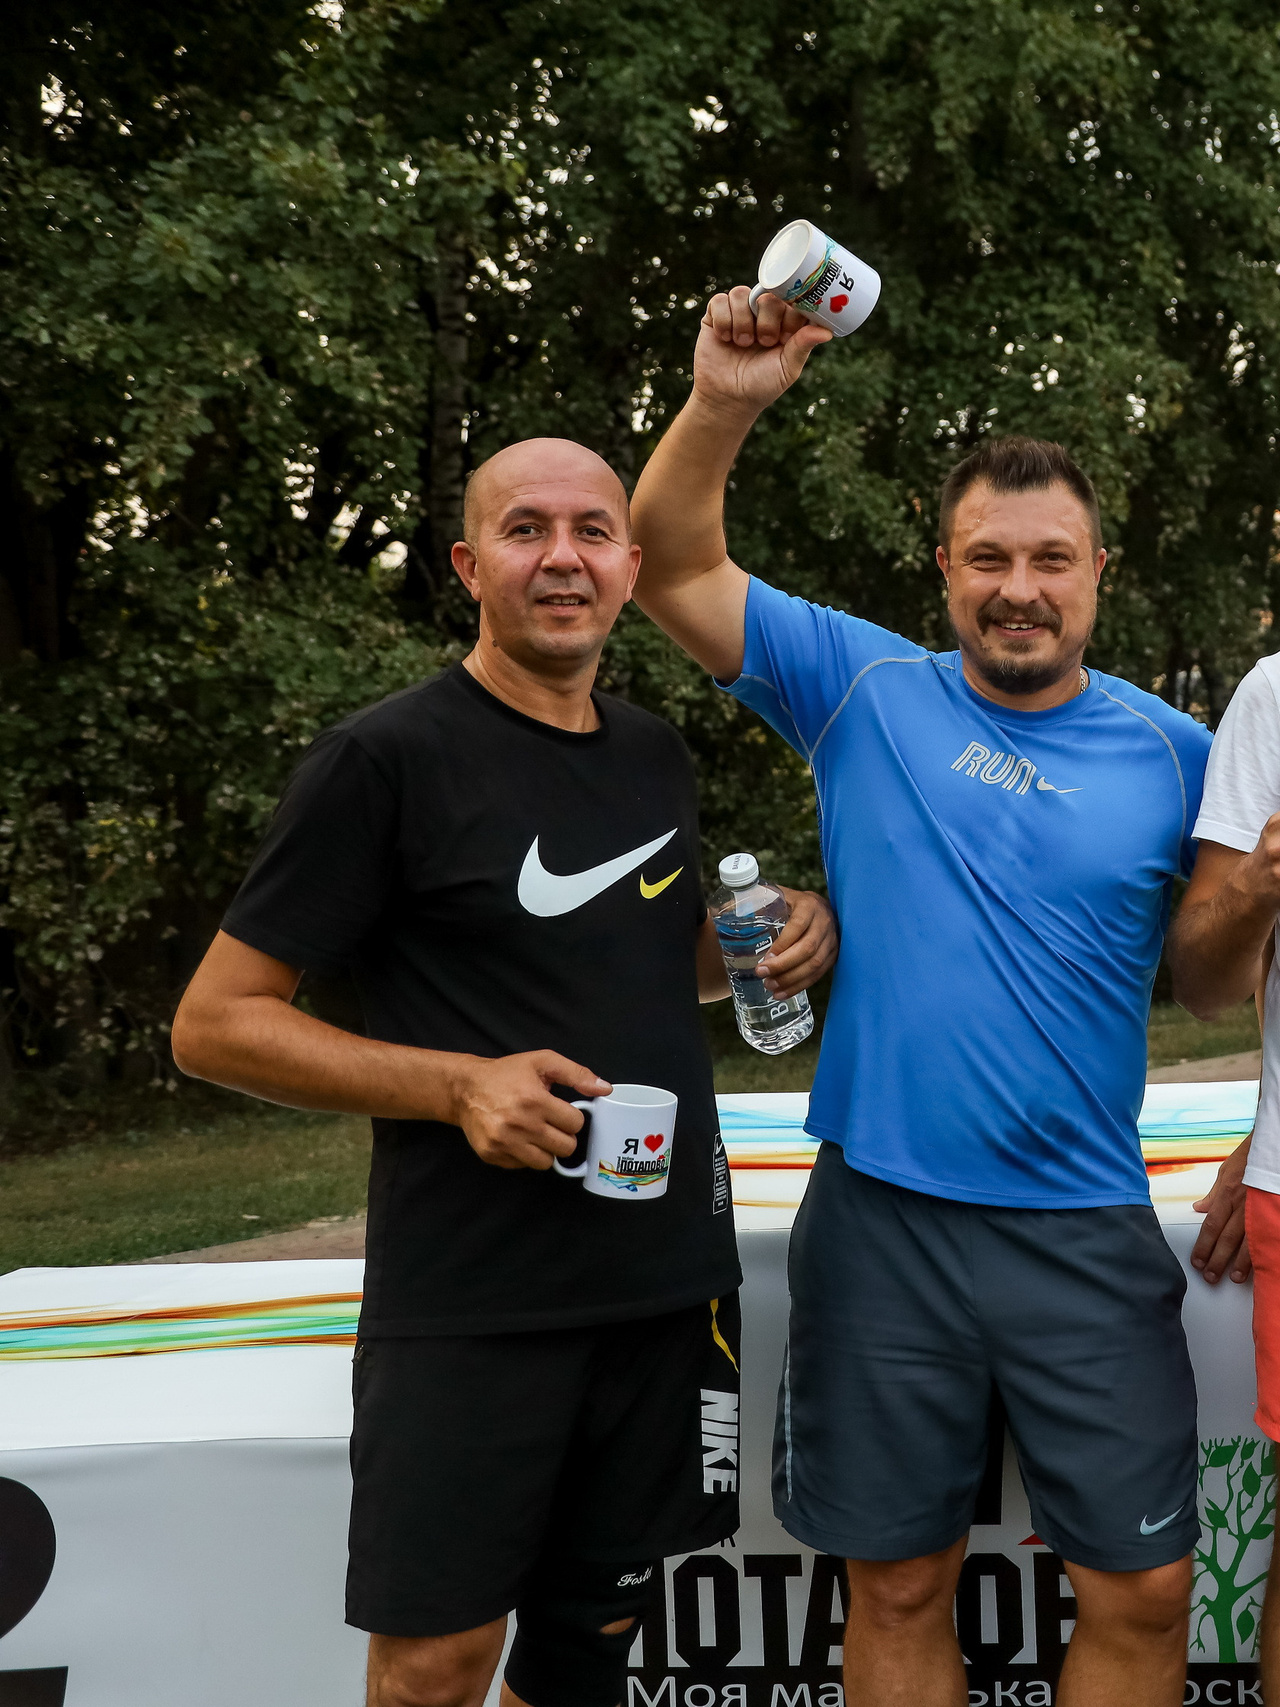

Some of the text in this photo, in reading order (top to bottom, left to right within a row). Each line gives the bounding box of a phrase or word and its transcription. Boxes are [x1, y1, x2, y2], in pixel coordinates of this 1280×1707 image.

[807, 262, 839, 304] ПОТАПОВО
[838, 271, 855, 292] Я
[950, 740, 1037, 795] RUN
[622, 1138, 639, 1155] Я
[620, 1159, 666, 1173] ПОТАПОВО
[700, 1388, 739, 1494] NIKE
